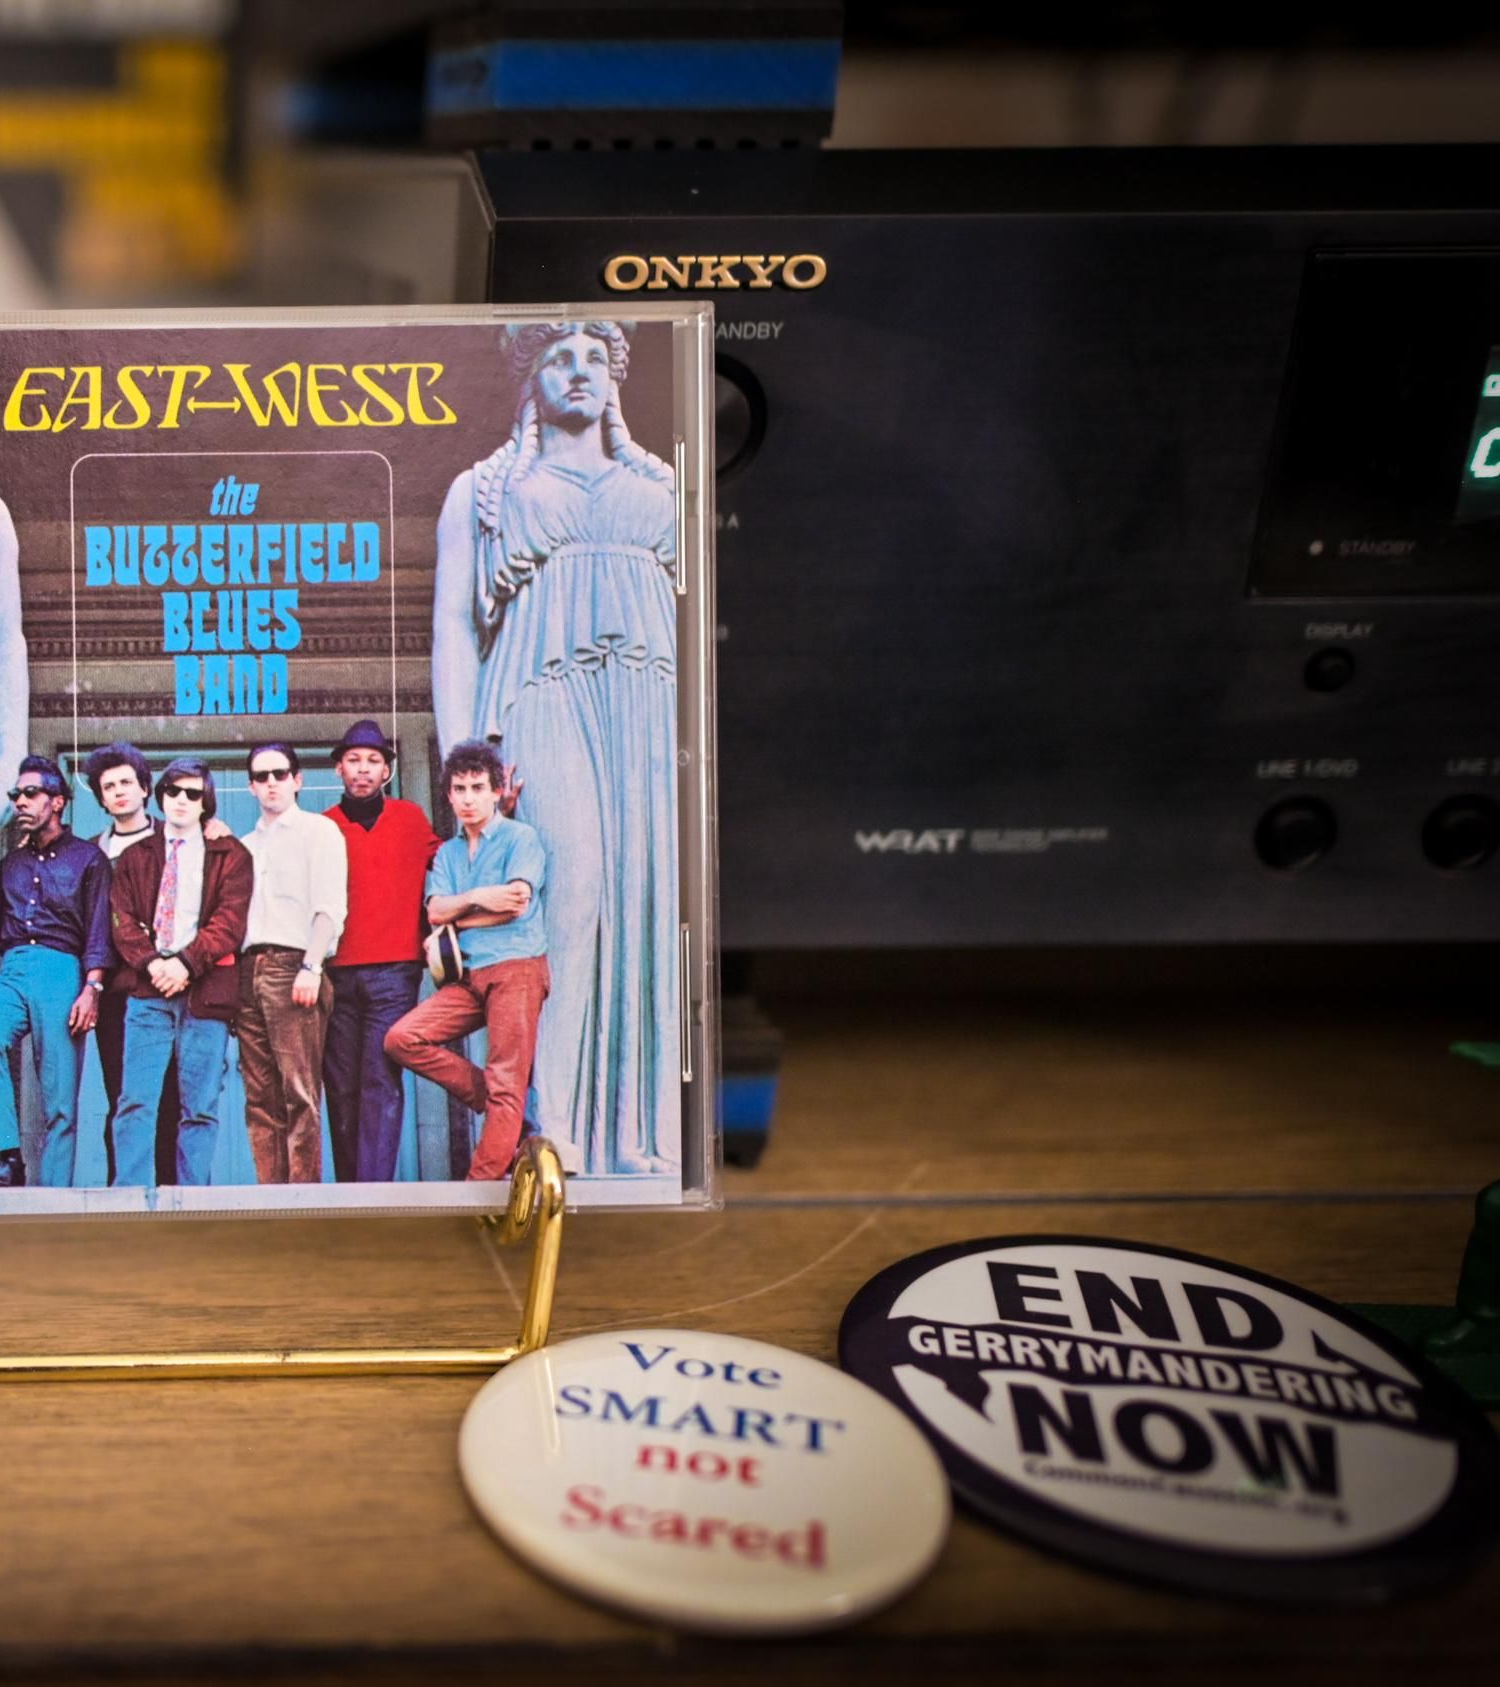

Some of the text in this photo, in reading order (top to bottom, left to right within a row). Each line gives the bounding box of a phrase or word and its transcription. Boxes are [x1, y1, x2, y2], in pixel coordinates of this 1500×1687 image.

[604, 254, 827, 290] ONKYO
[714, 321, 784, 339] ANDBY
[210, 475, 259, 516] the
[84, 521, 380, 586] BUTTERFIELD
[162, 588, 301, 652] BLUES
[1304, 622, 1374, 640] DISPLAY
[174, 653, 288, 714] BAND
[986, 1260, 1285, 1352] END
[620, 1342, 782, 1390] Vote
[906, 1323, 1418, 1420] GERRYMANDERING
[555, 1385, 846, 1456] SMART
[1007, 1380, 1342, 1498] NOW
[635, 1443, 763, 1487] not
[560, 1483, 828, 1572] Scared
